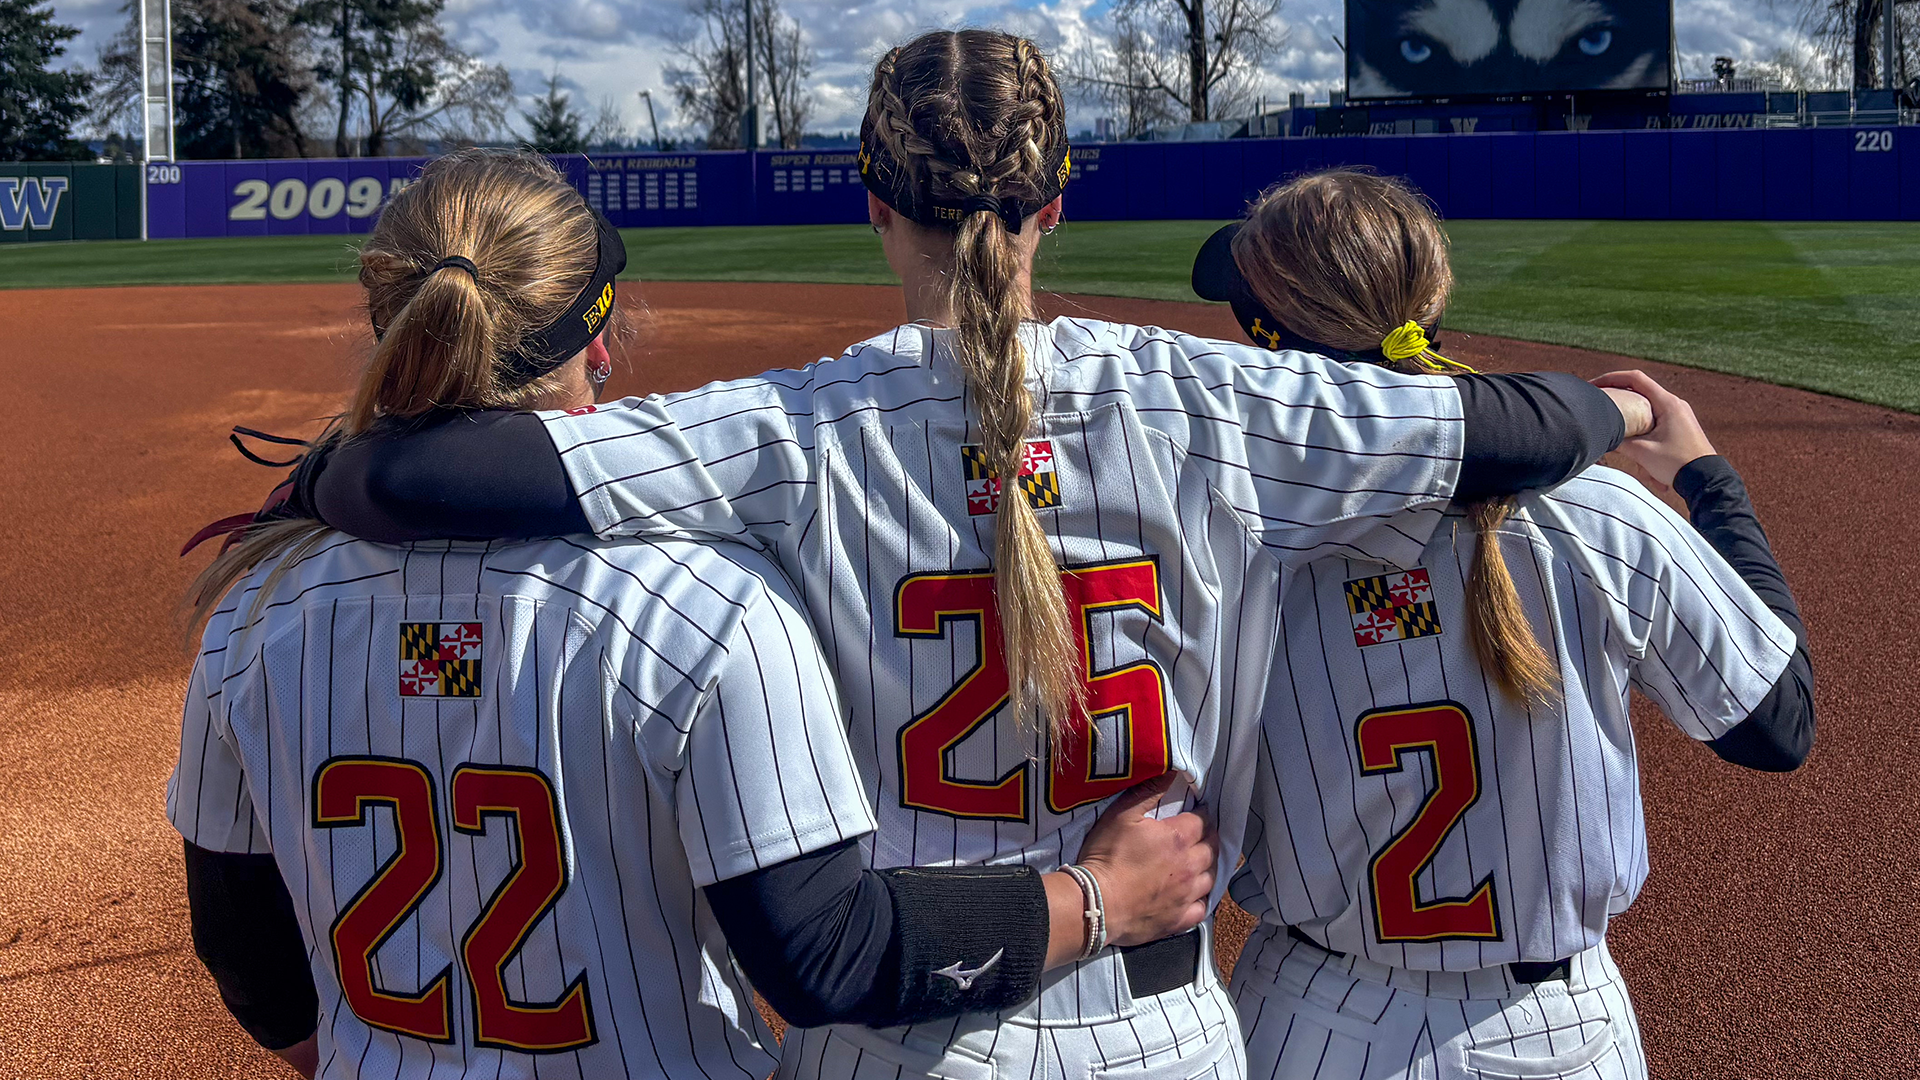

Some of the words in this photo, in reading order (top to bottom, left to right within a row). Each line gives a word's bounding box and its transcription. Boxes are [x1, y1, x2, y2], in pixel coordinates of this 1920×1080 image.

[771, 155, 811, 167] SUPER
[1855, 130, 1893, 152] 220
[148, 166, 181, 184] 200
[626, 157, 697, 170] REGIONALS
[0, 176, 69, 230] W
[229, 177, 382, 220] 2009
[893, 554, 1173, 824] 26
[1353, 699, 1504, 944] 2
[311, 754, 600, 1054] 22
